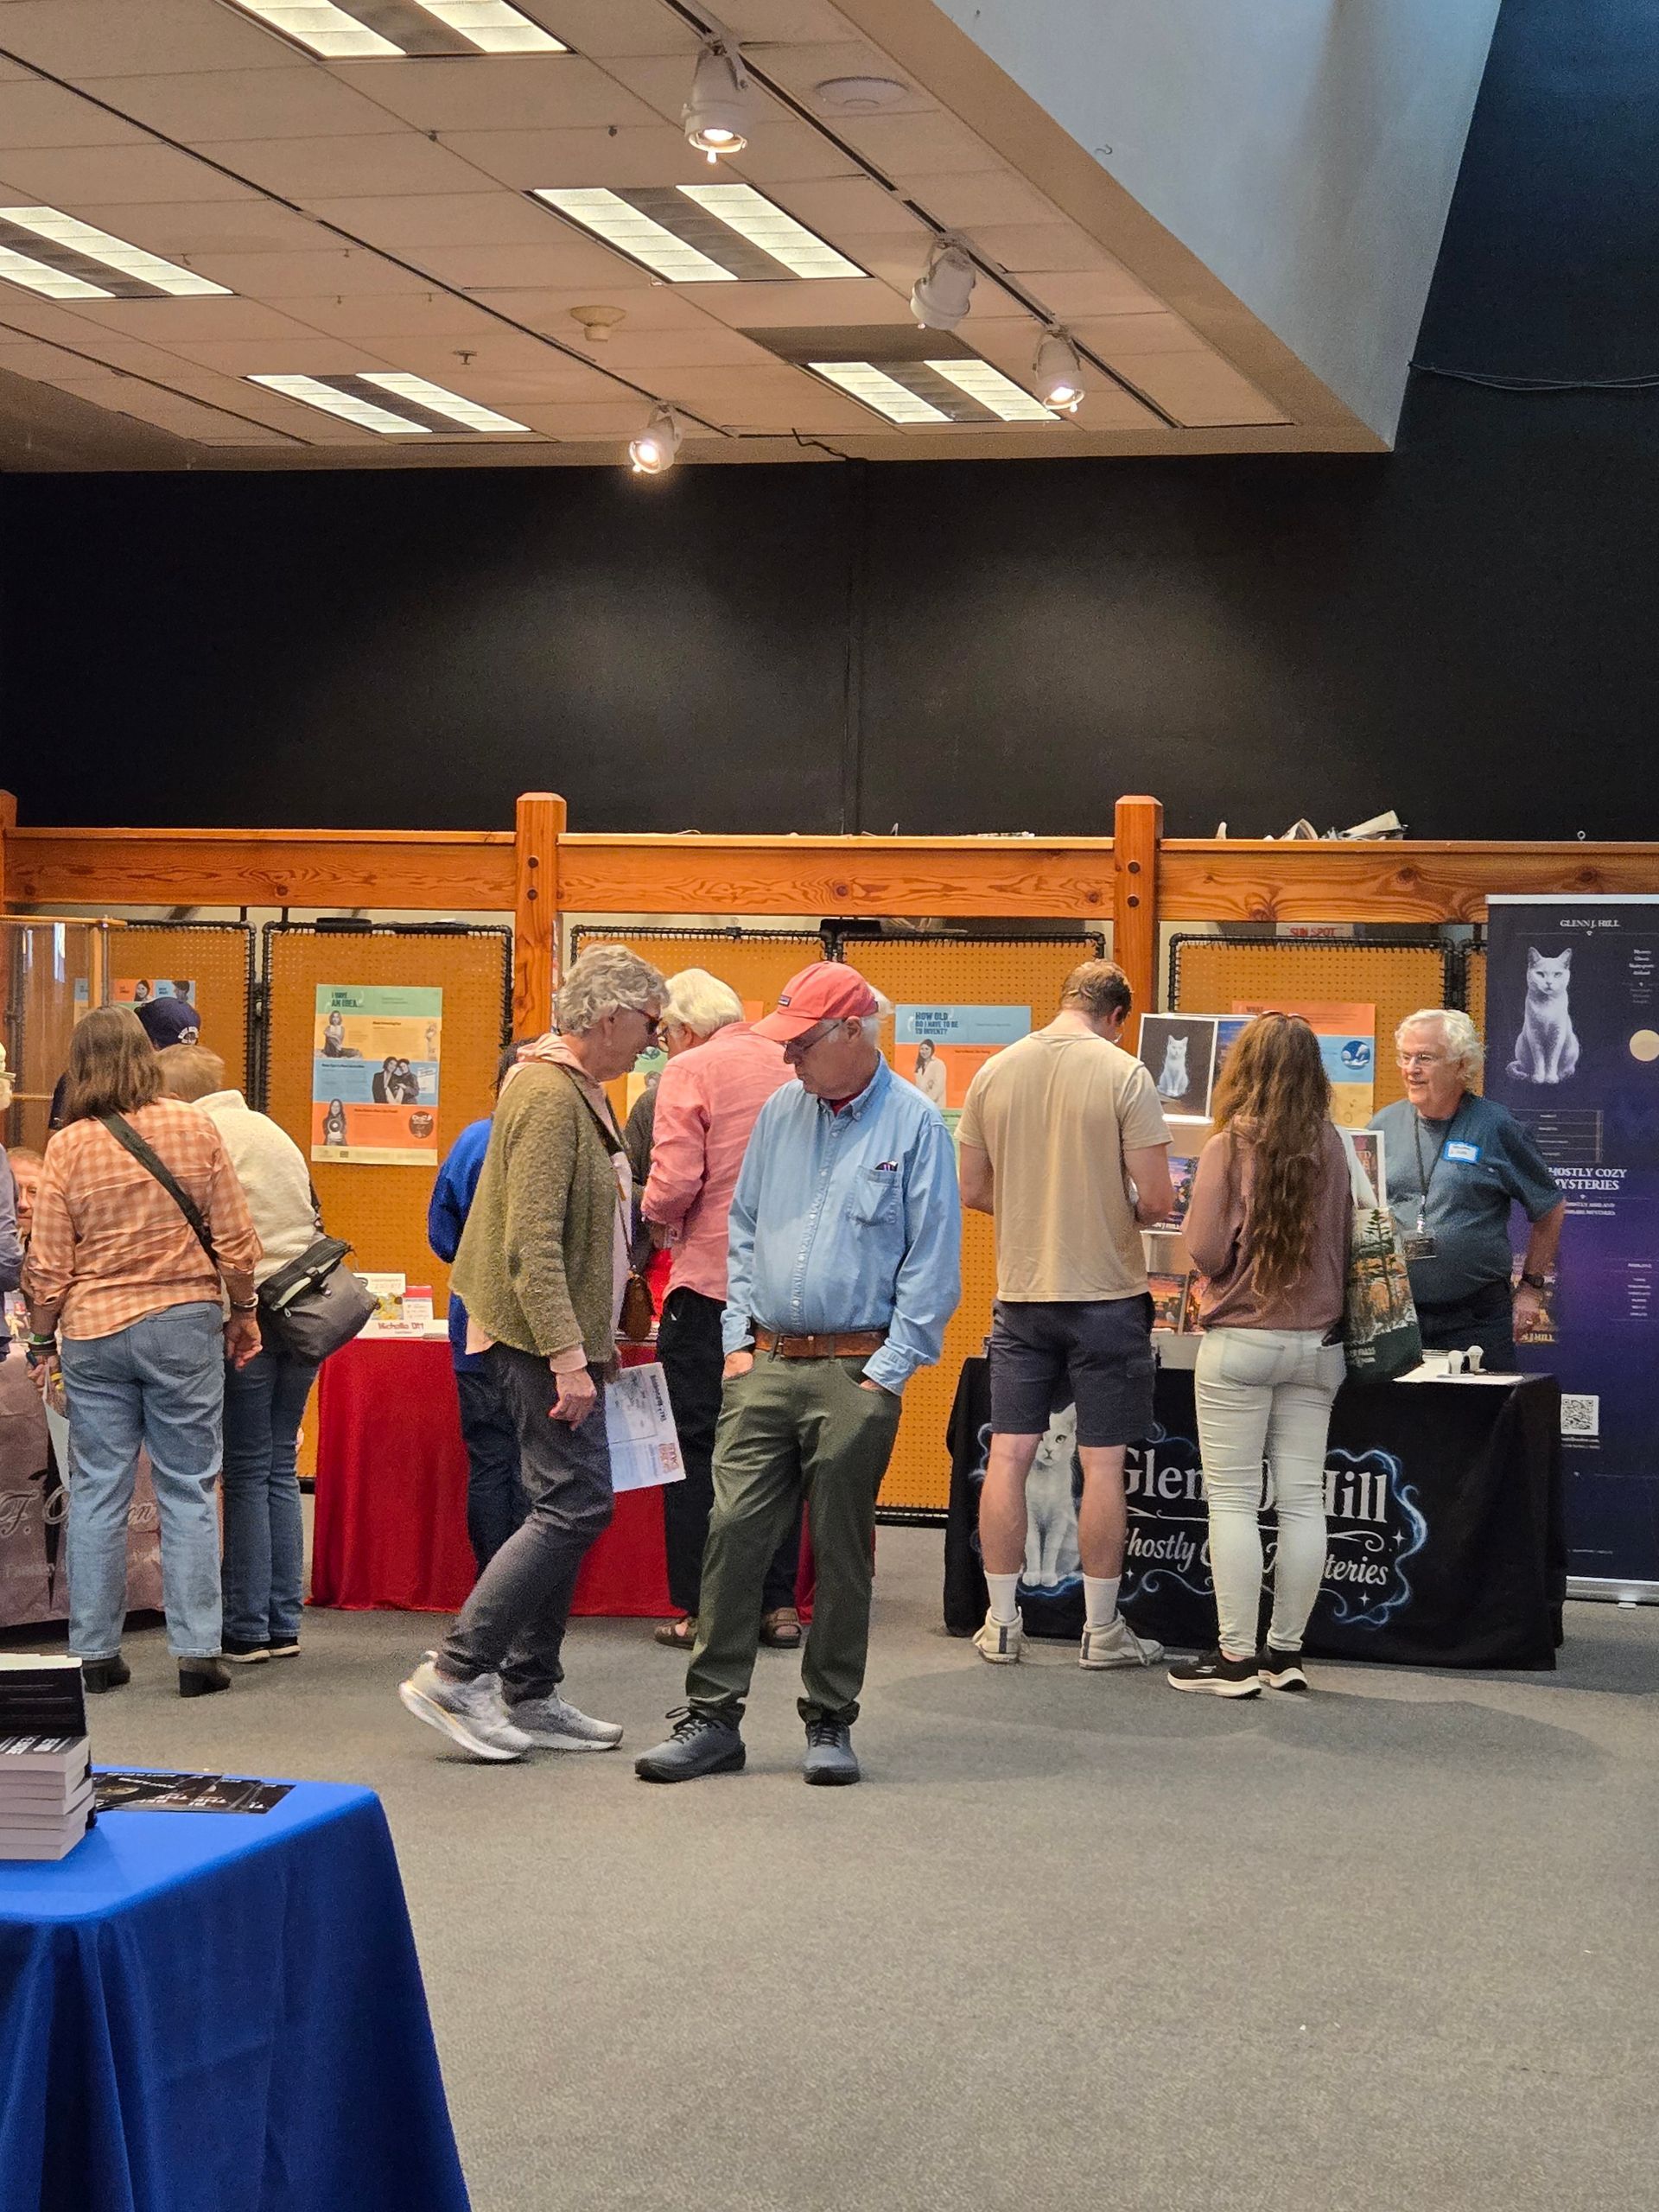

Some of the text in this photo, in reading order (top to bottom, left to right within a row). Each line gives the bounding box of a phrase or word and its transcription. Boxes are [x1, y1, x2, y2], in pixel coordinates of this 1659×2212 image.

[915, 1012, 949, 1020] HOW OLD
[1548, 1166, 1628, 1179] HOSTLY COZY
[1124, 1447, 1208, 1501] Glen
[1125, 1527, 1197, 1573] hostly
